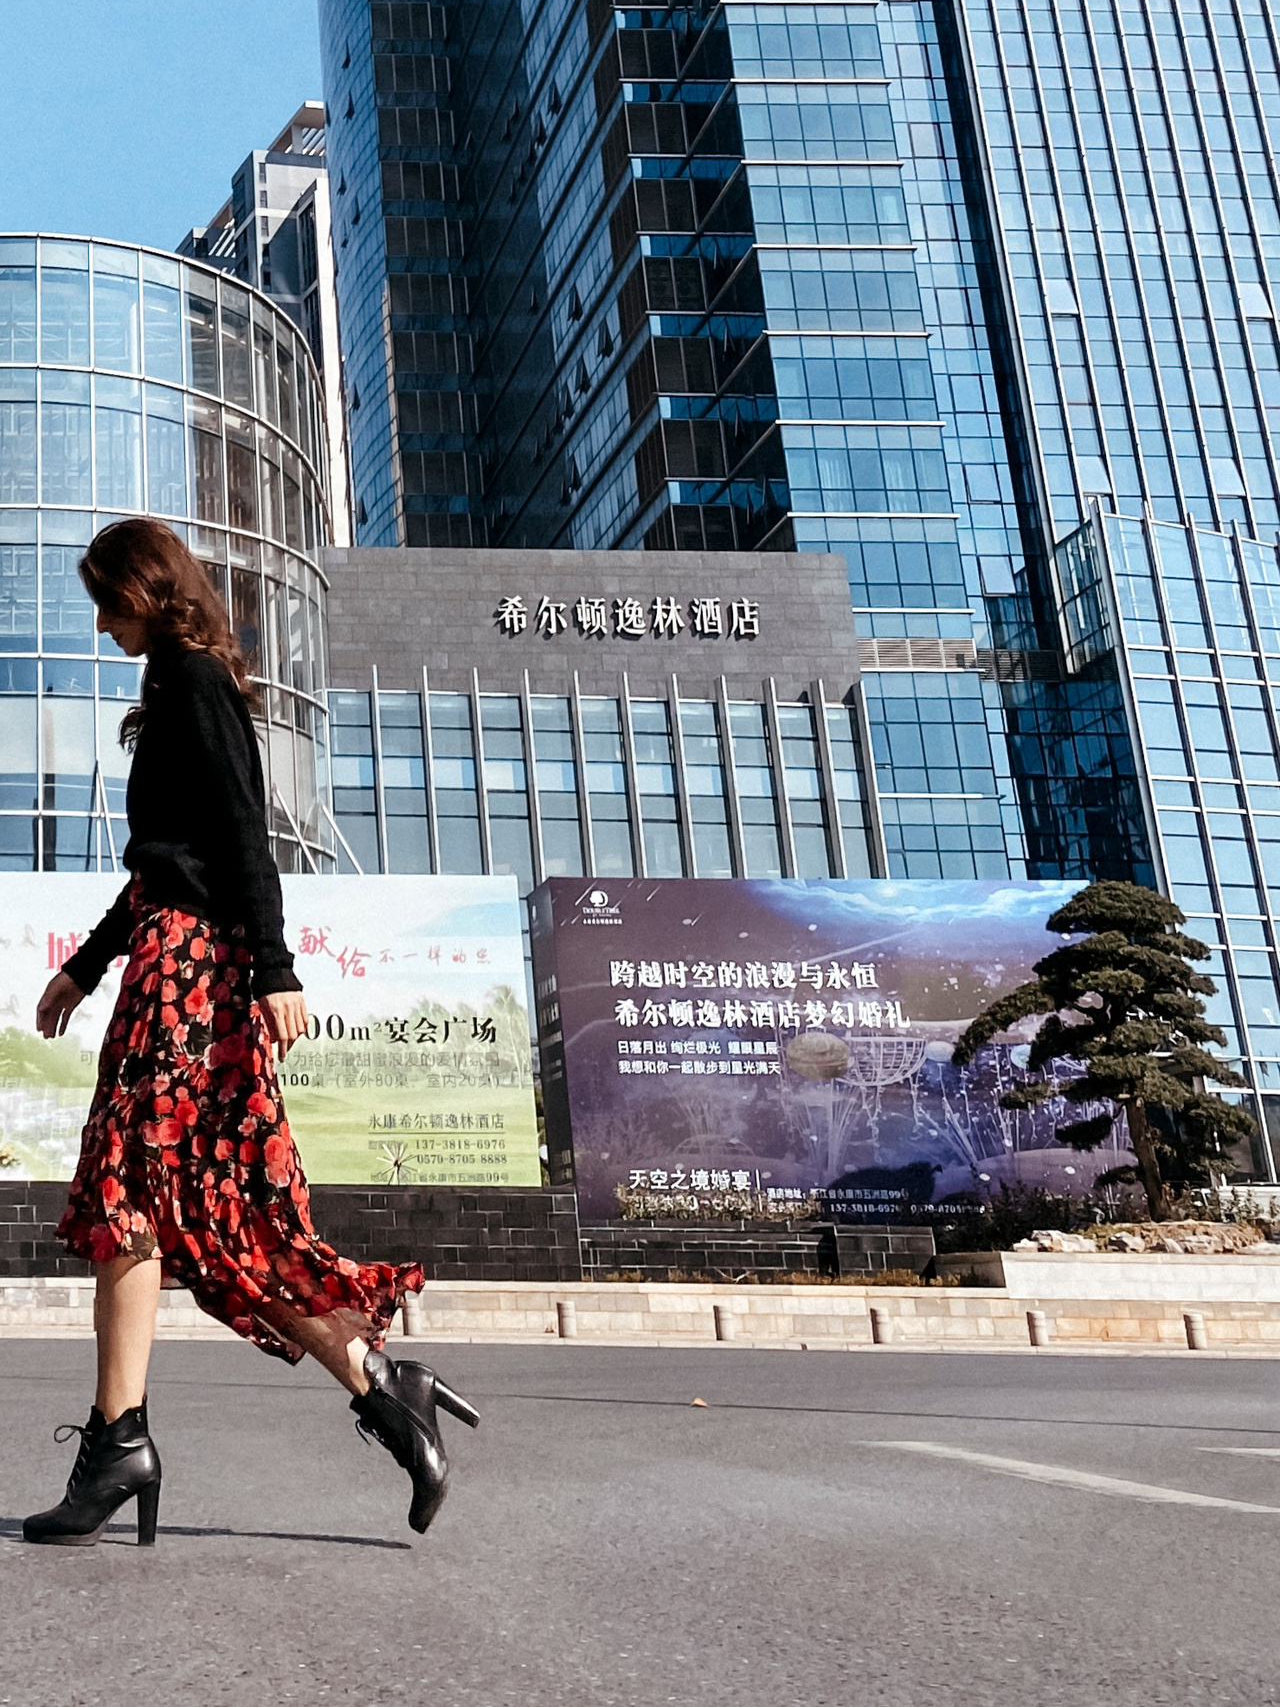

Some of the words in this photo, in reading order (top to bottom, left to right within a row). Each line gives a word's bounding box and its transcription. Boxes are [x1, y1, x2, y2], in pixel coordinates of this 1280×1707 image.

[497, 595, 760, 636] 希尔顿逸林酒店
[610, 960, 879, 989] 跨越时空的浪漫与永恒
[614, 999, 911, 1029] 希尔顿逸林酒店梦幻婚礼
[618, 1040, 667, 1054] 日落月出
[368, 1113, 505, 1130] 永康希尔顿逸林酒店
[415, 1139, 506, 1150] 137-3818-6976
[481, 1154, 508, 1164] 8888
[628, 1168, 752, 1191] 天空之境婚宴
